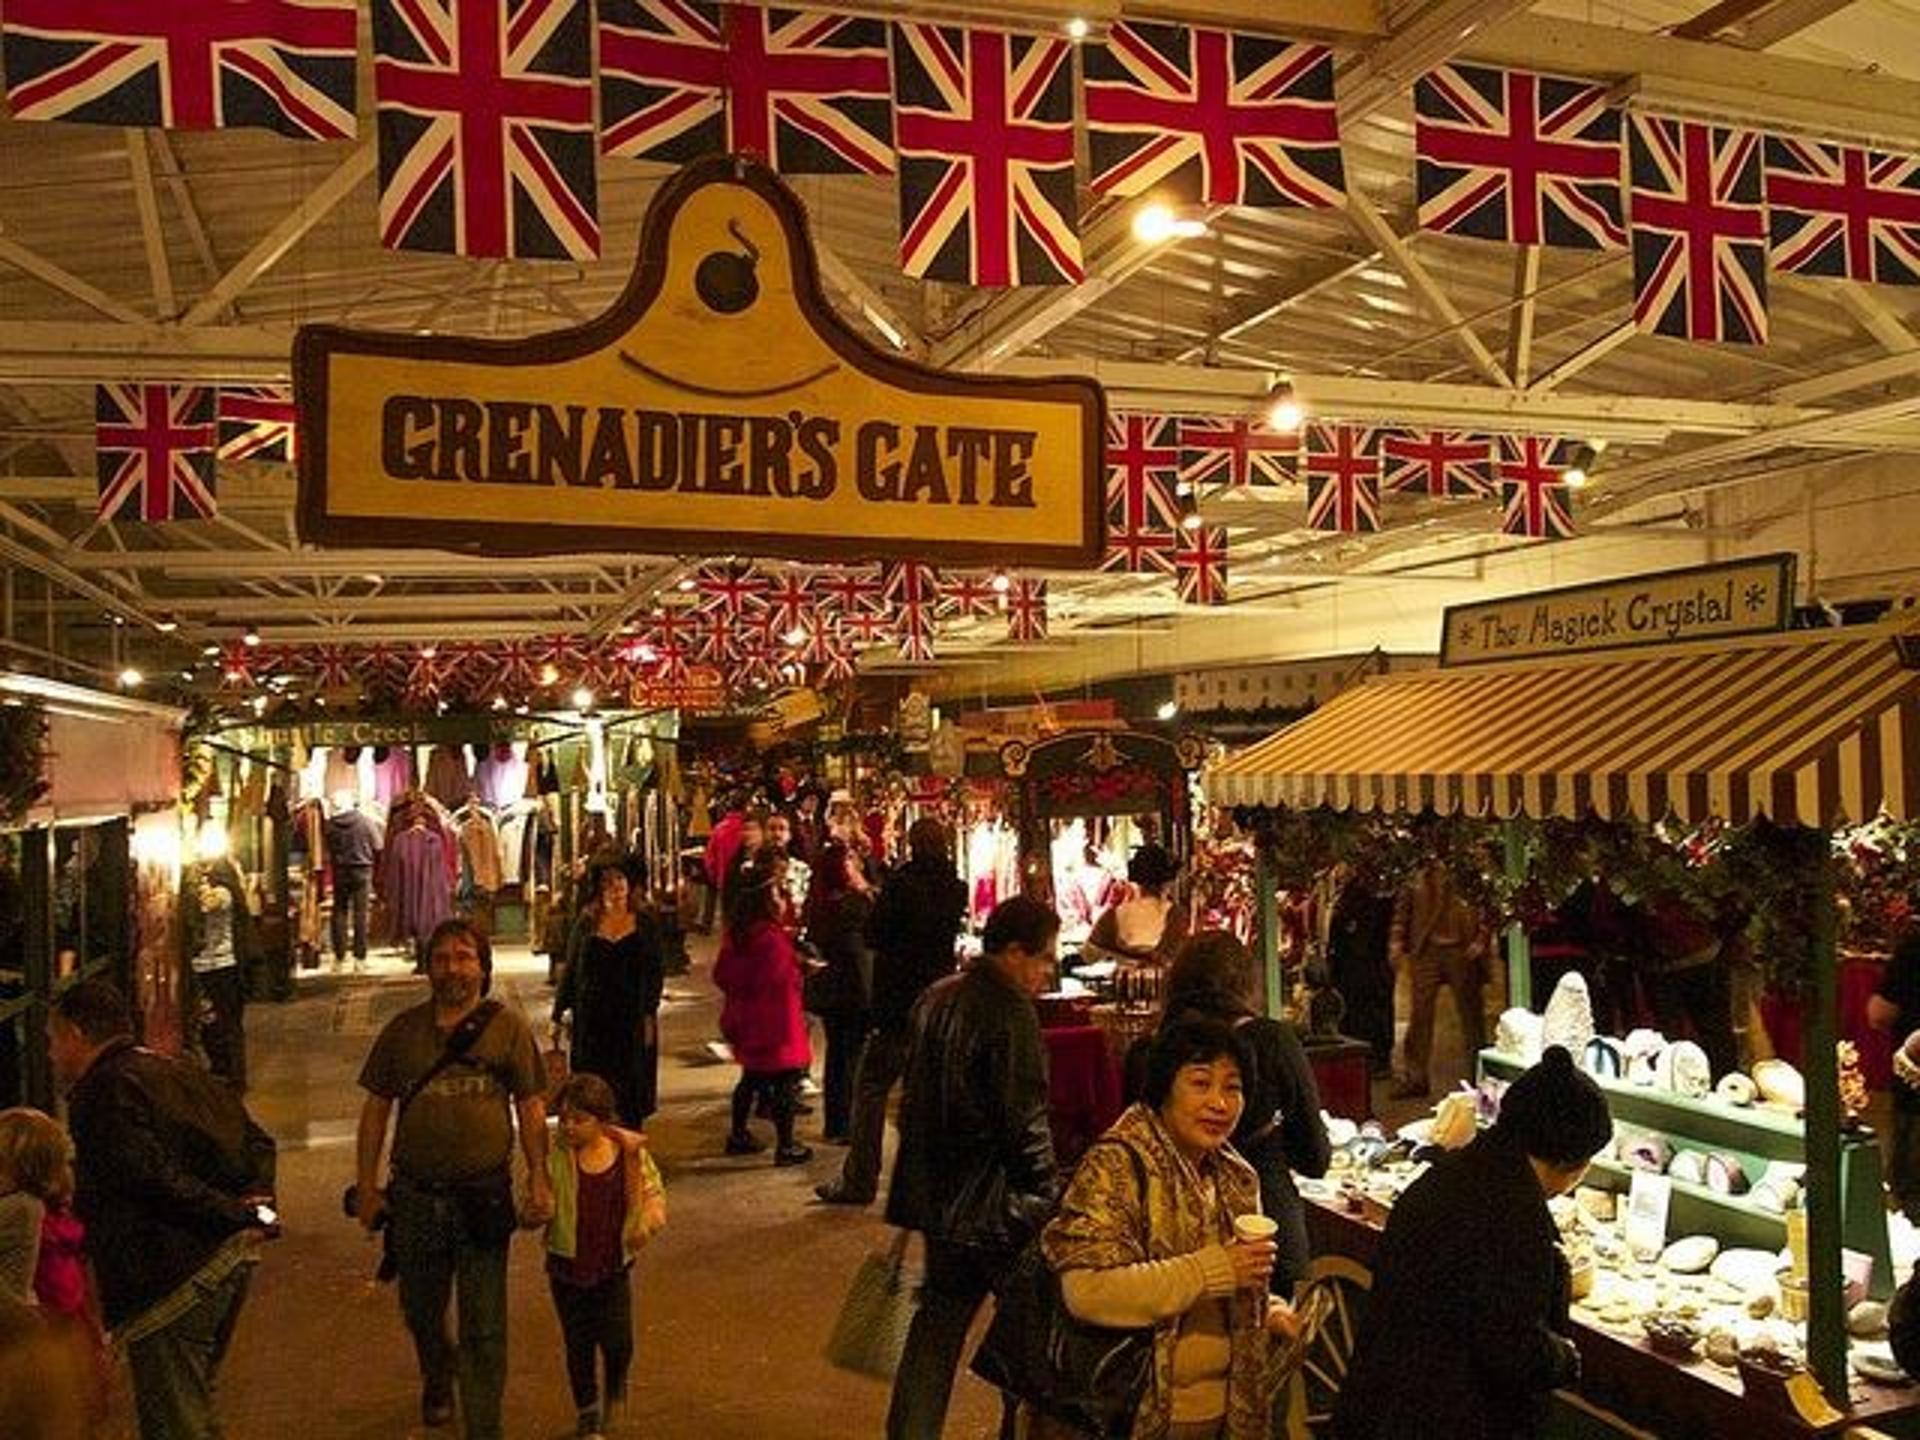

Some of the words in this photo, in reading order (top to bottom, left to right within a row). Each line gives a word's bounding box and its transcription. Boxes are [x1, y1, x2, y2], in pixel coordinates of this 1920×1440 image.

[380, 395, 840, 502] GRENADIER'S
[855, 420, 1038, 508] GATE
[1479, 614, 1518, 650] The
[1528, 599, 1618, 645] Magick
[1627, 579, 1733, 640] Crystal
